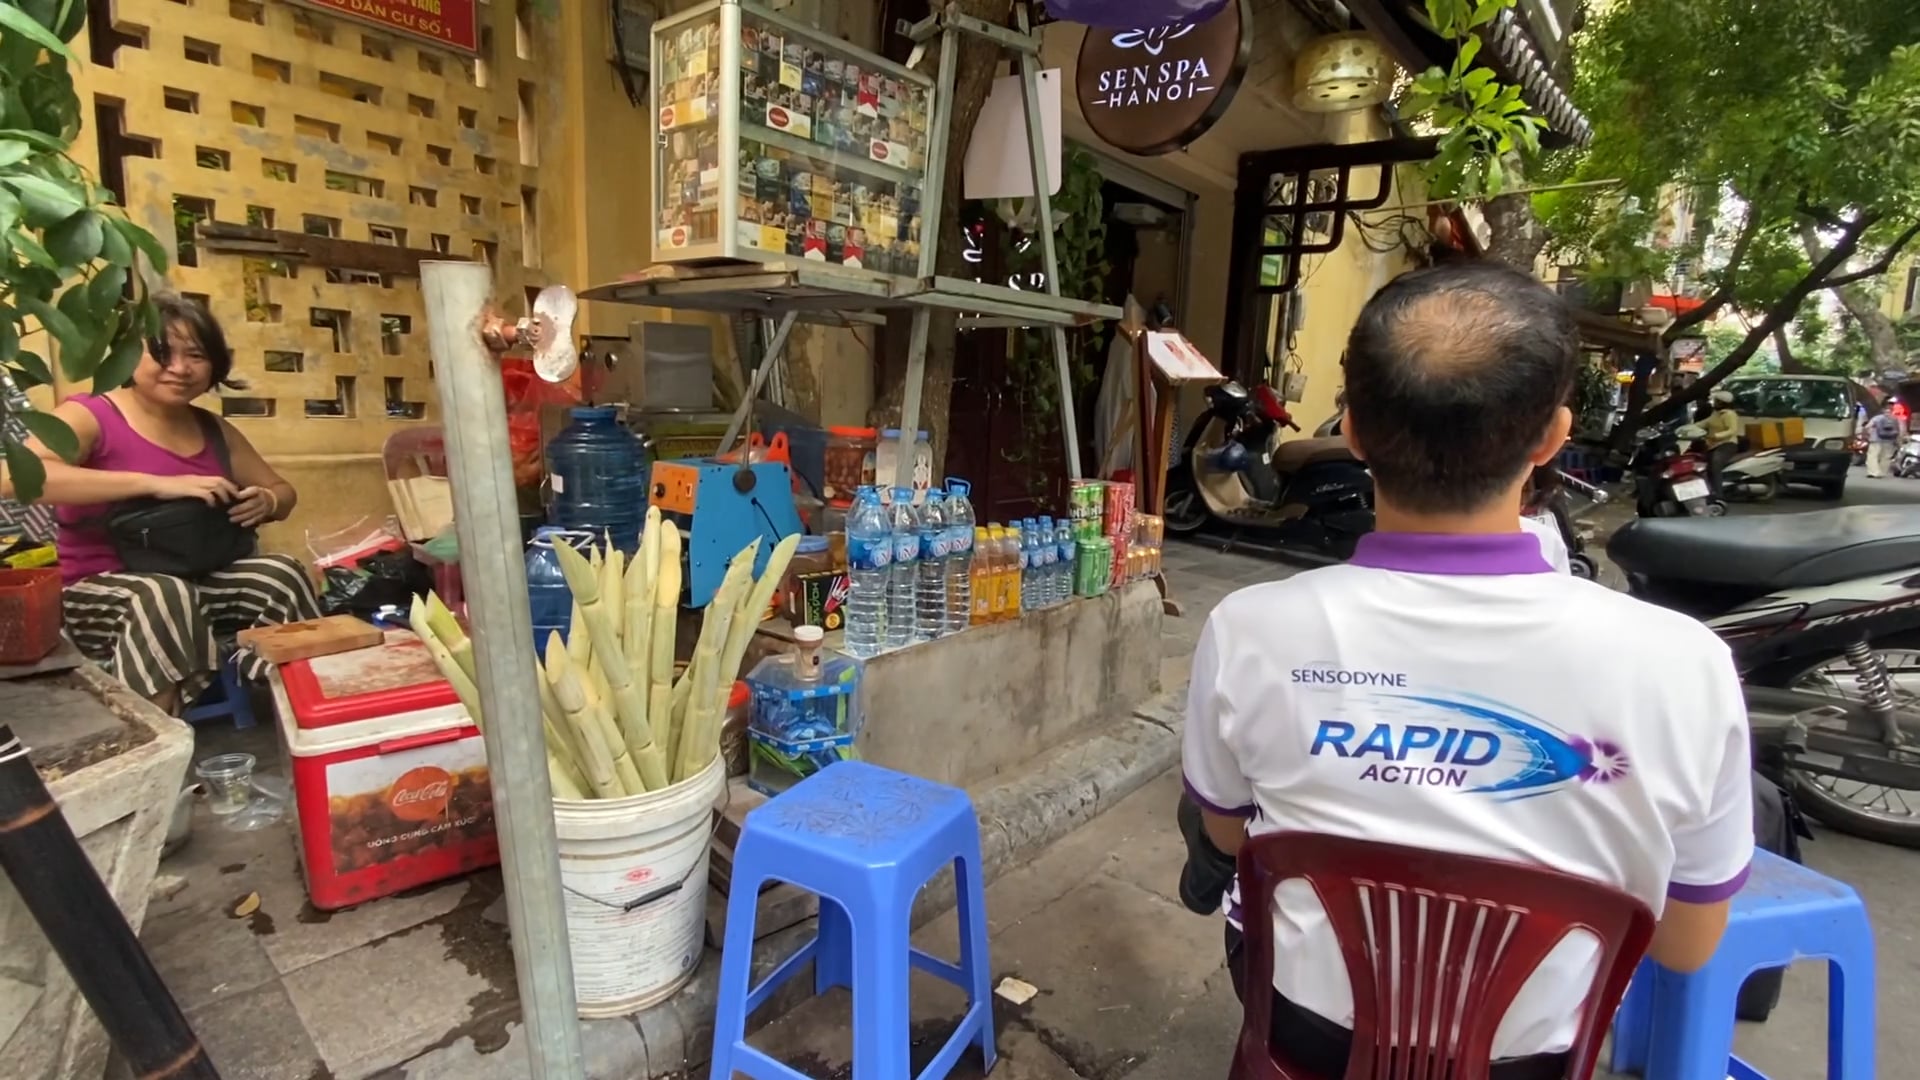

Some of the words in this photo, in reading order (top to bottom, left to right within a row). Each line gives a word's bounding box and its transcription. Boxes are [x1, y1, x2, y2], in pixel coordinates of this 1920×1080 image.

[445, 27, 452, 38] 1
[1098, 64, 1150, 92] SEN
[1157, 57, 1211, 84] SPA
[1291, 668, 1407, 688] SENSODYNE
[1310, 719, 1501, 767] RAPID
[1359, 764, 1468, 787] ACTION
